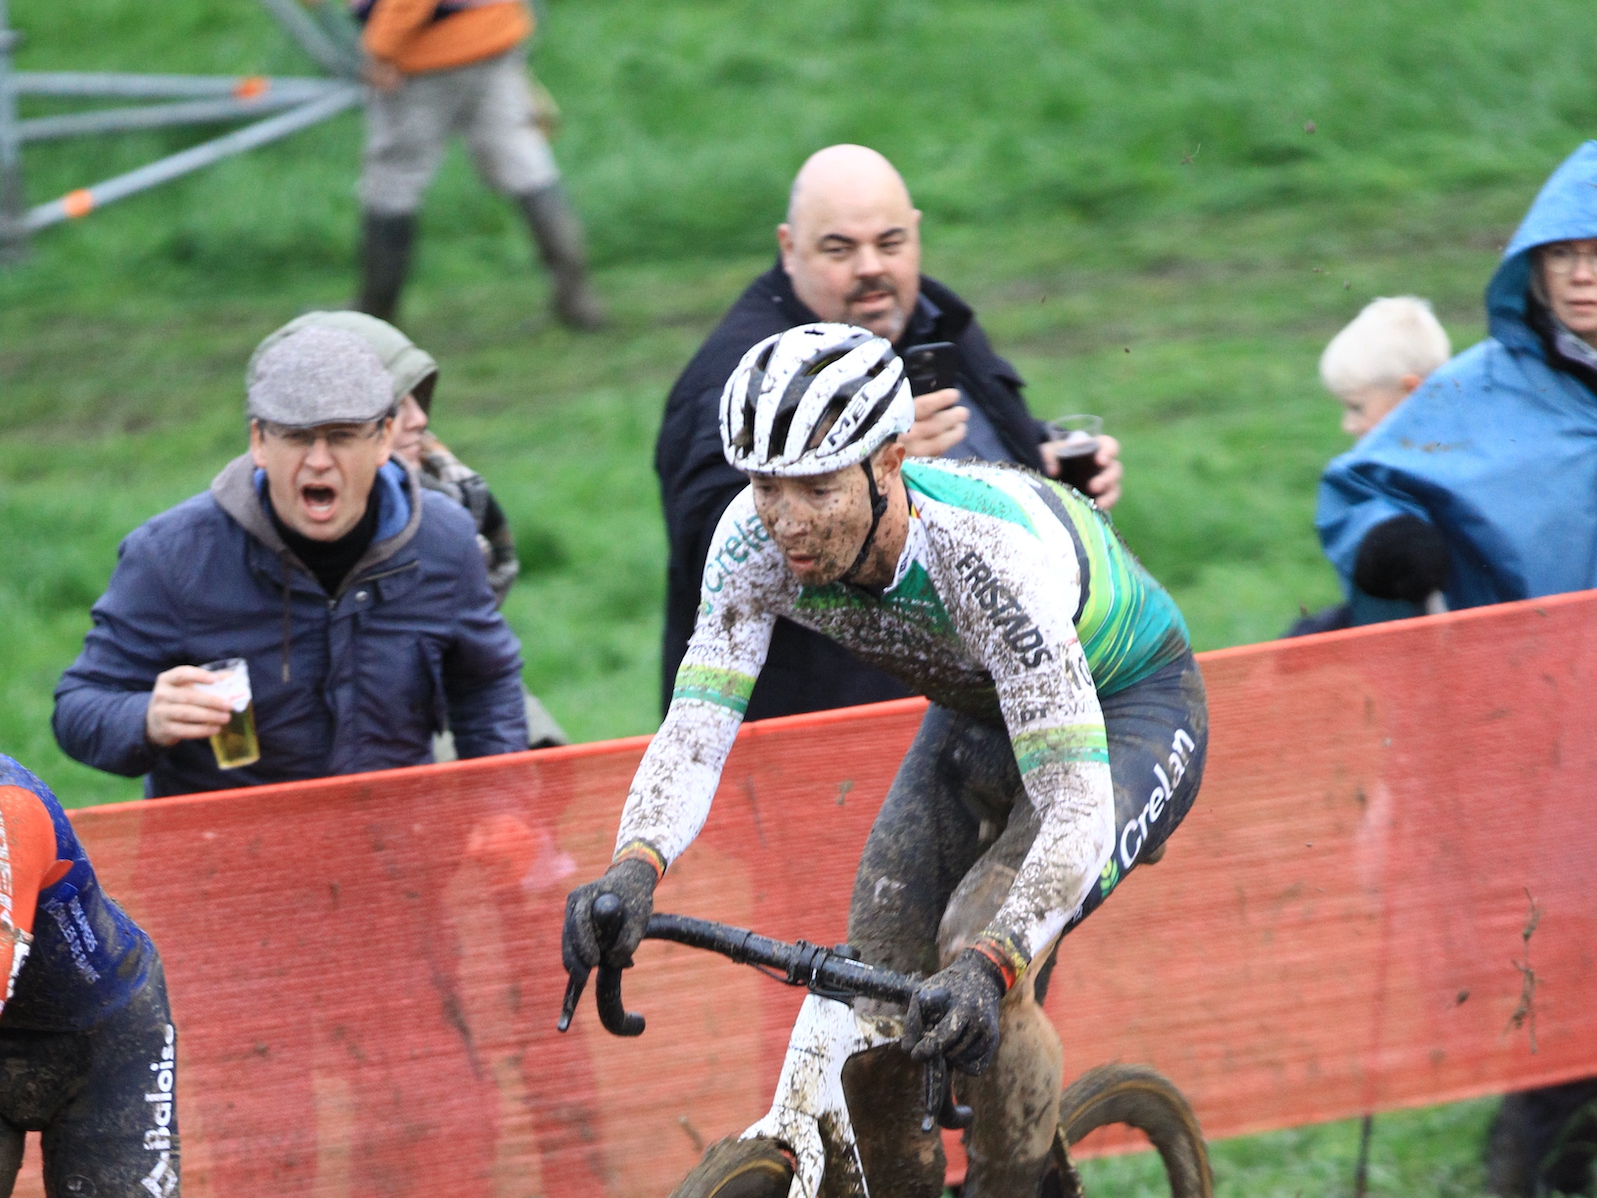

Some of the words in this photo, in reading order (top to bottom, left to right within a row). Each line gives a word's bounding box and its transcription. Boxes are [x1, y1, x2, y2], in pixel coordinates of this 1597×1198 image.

[827, 387, 869, 446] MET
[705, 514, 770, 589] Crela
[955, 551, 1052, 668] FRISTADS
[1120, 728, 1195, 869] Crelan
